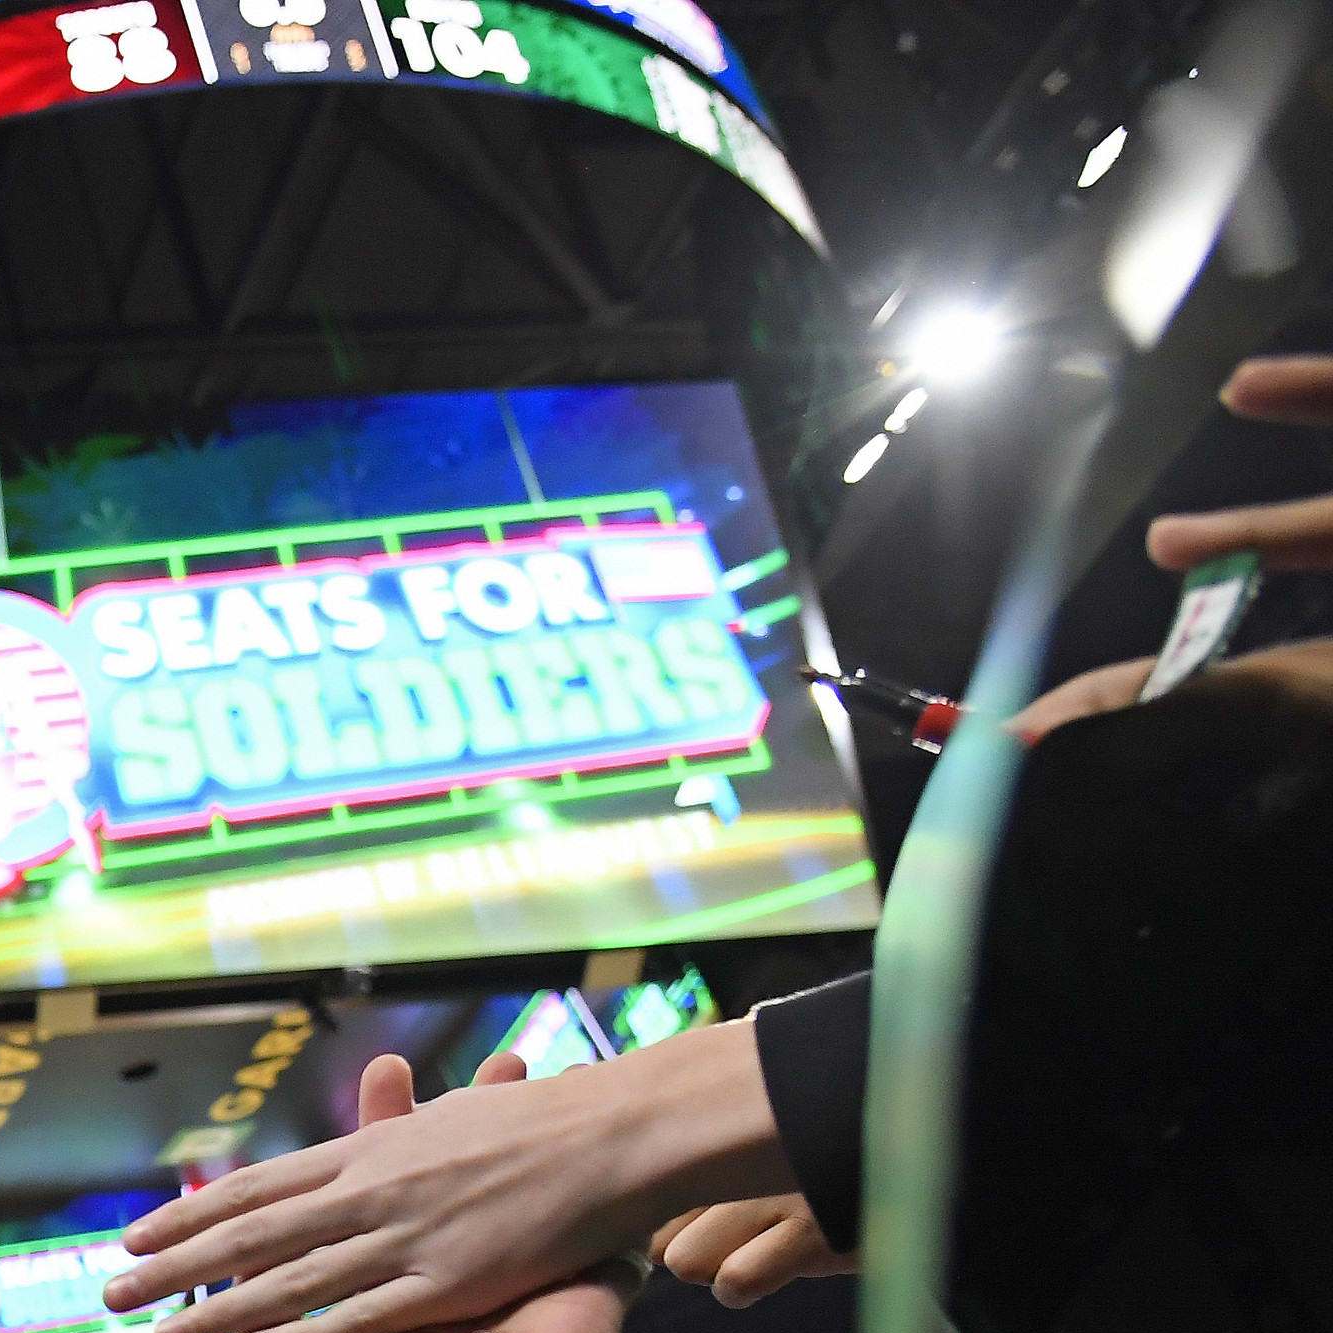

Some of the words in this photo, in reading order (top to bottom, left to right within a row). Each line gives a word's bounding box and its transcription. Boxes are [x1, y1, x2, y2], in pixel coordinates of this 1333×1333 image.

[391, 17, 530, 84] 104
[92, 574, 387, 679] SEATS
[401, 550, 613, 642] FOR
[111, 617, 751, 805] SOLDIERS
